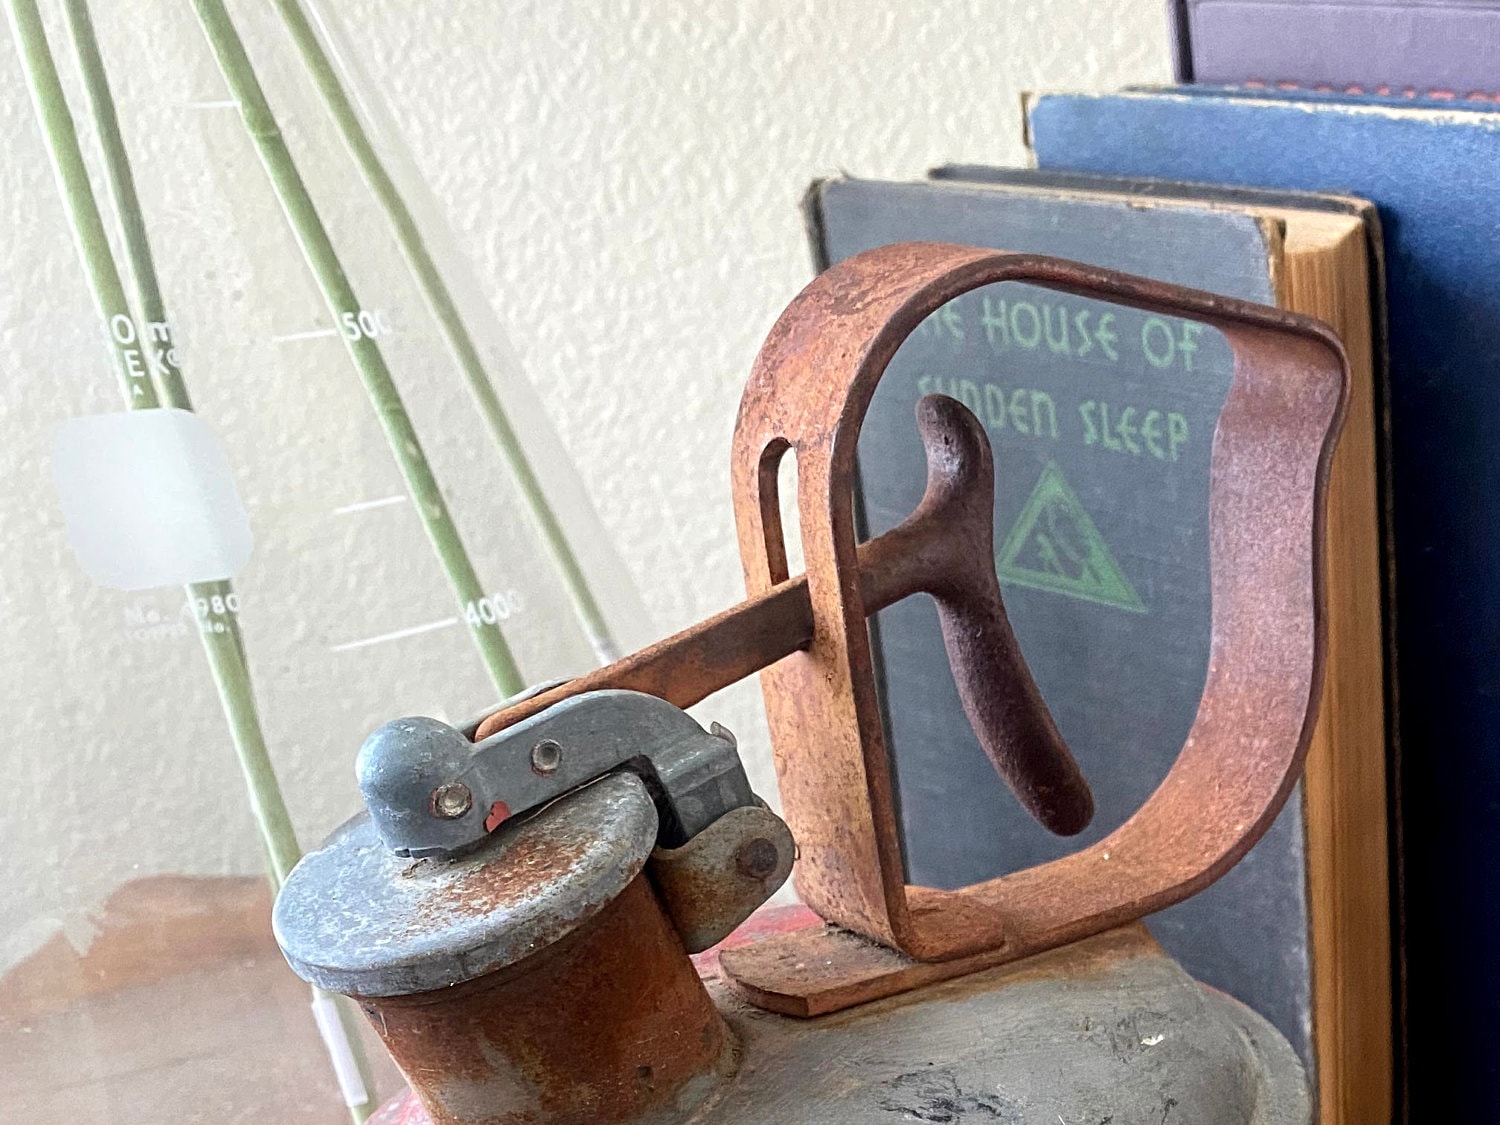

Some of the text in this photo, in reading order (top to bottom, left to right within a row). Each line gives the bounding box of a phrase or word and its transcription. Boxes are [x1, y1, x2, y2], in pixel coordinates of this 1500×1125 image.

[982, 295, 1119, 361] HOUSE
[1141, 318, 1204, 372] OF
[1079, 400, 1189, 462] SLEEP
